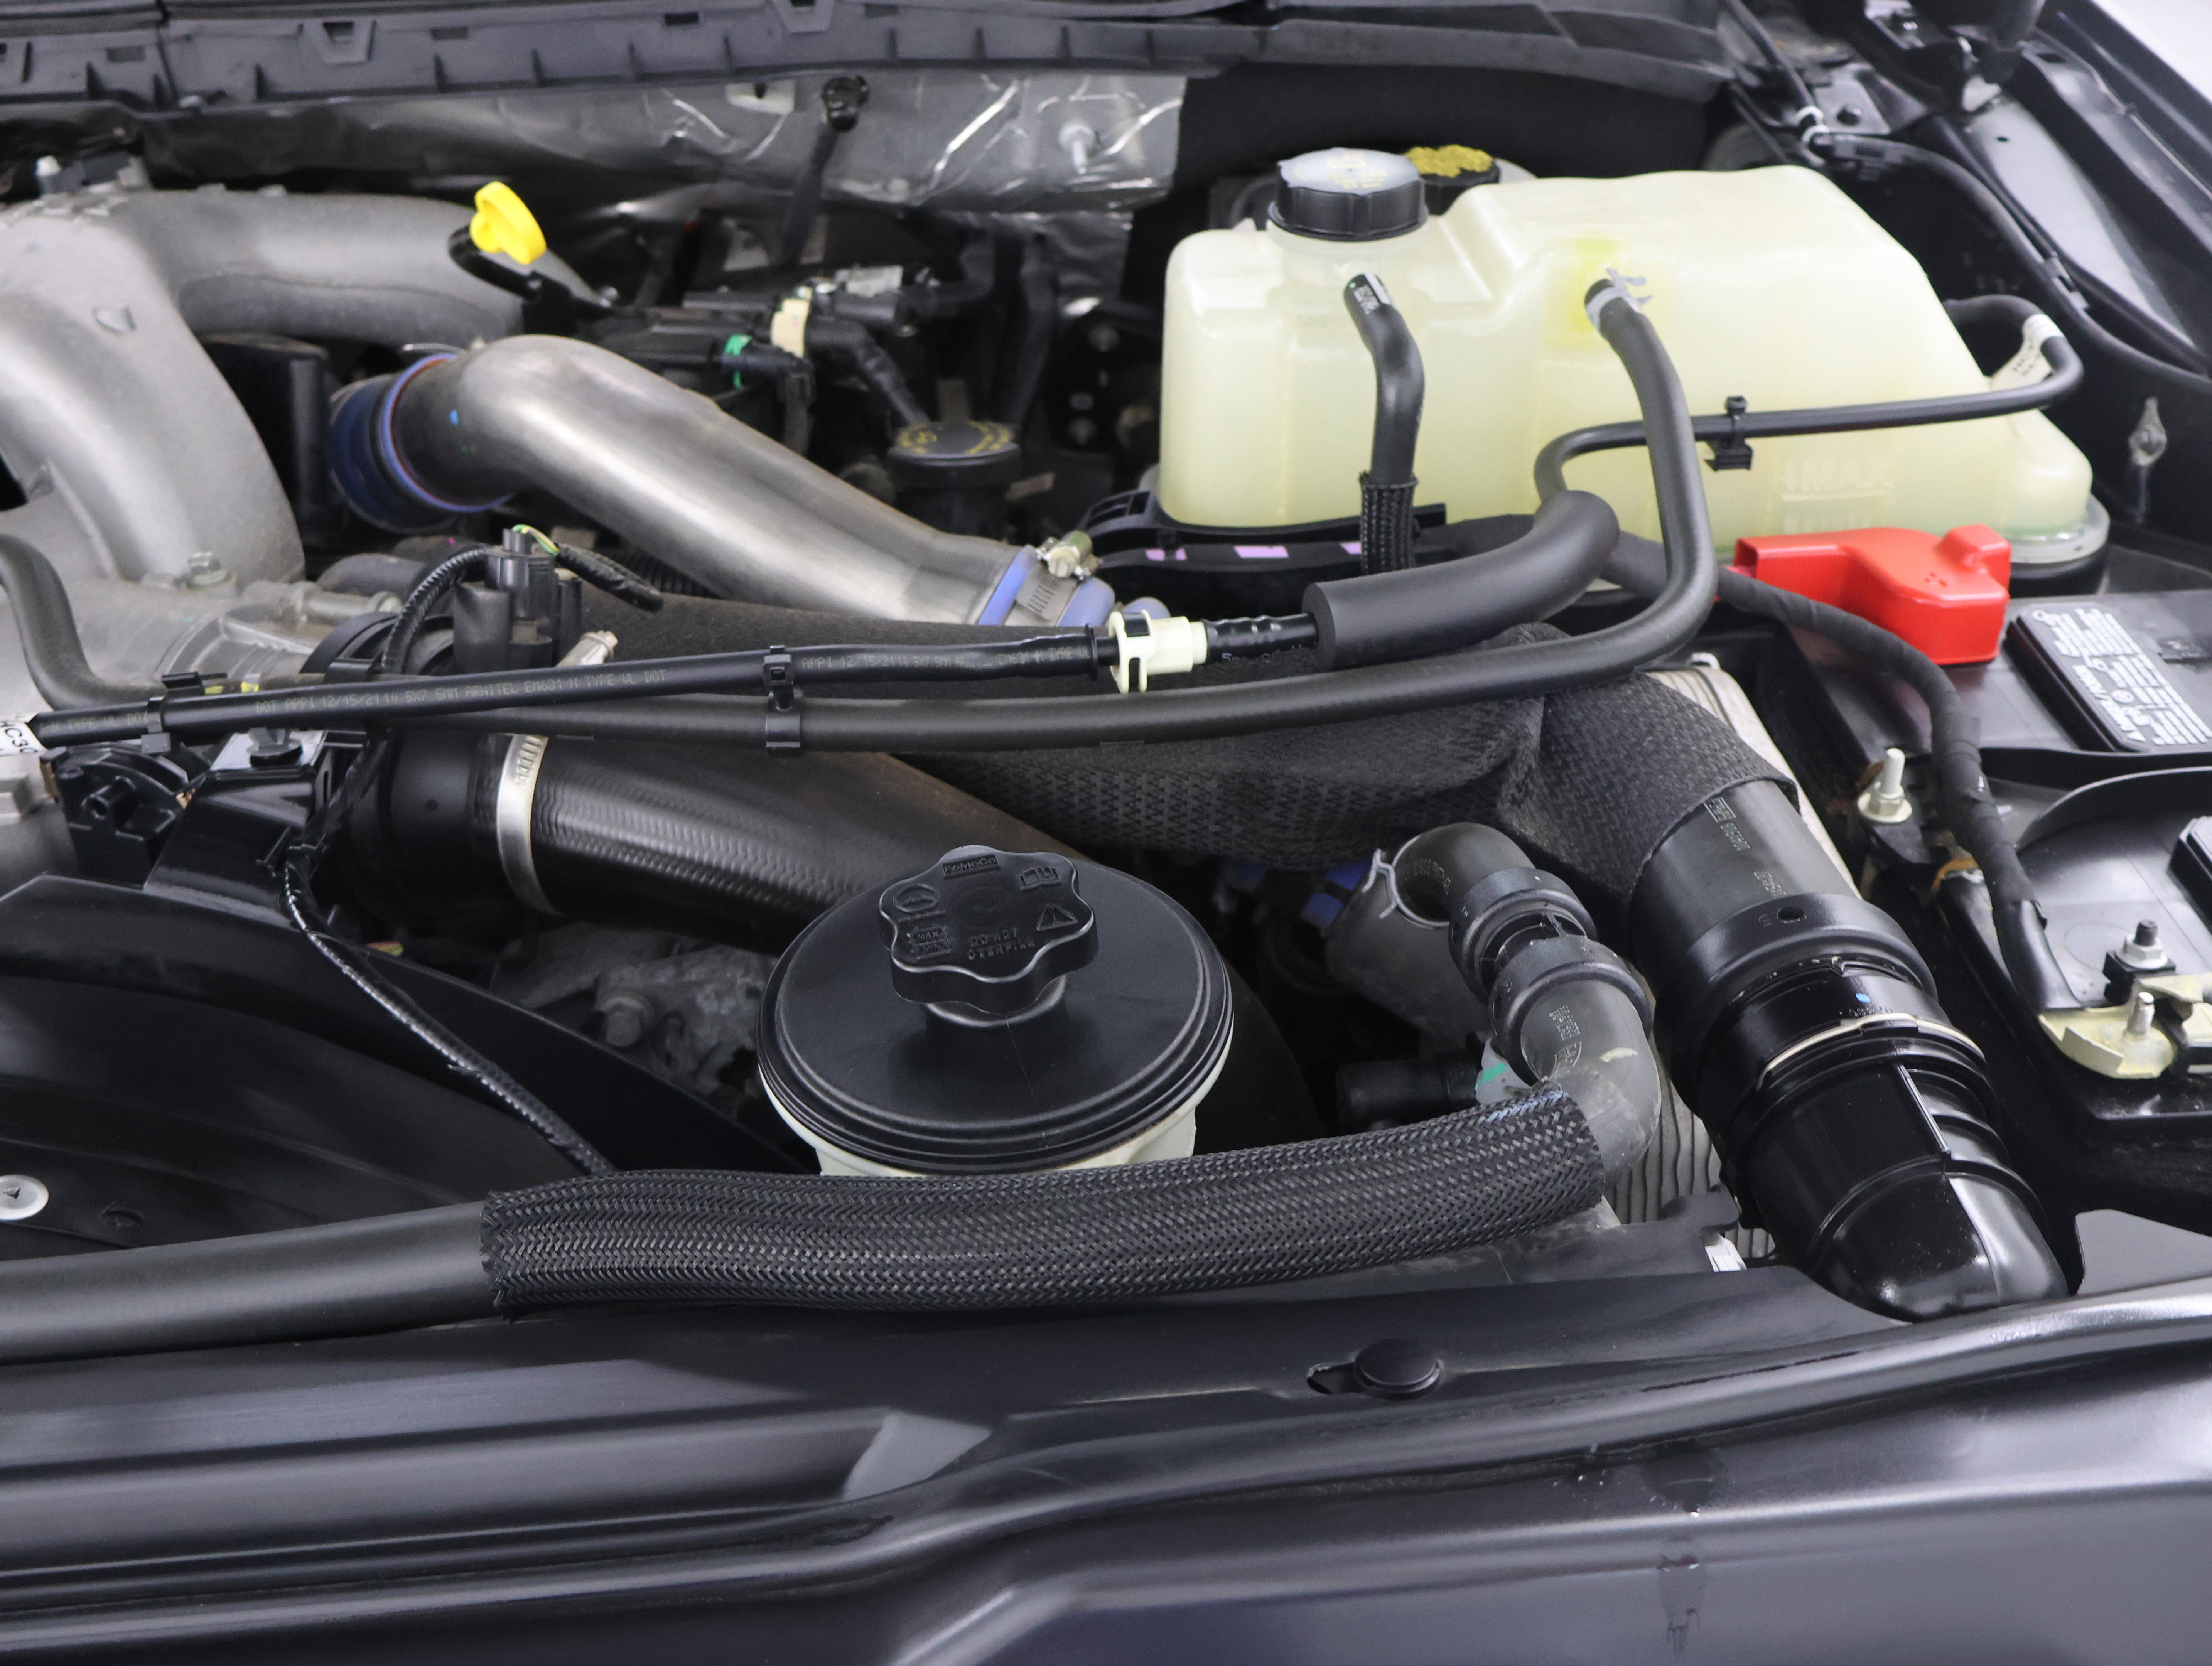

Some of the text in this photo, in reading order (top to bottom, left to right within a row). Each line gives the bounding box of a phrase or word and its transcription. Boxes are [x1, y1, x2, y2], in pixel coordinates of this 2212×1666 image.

[322, 693, 380, 708] 12/15/21
[585, 673, 615, 687] TYPE
[622, 673, 638, 684] UL
[643, 669, 666, 683] DOT
[944, 857, 997, 874] FoMoCo
[917, 930, 939, 941] MAX
[924, 943, 941, 953] MIN
